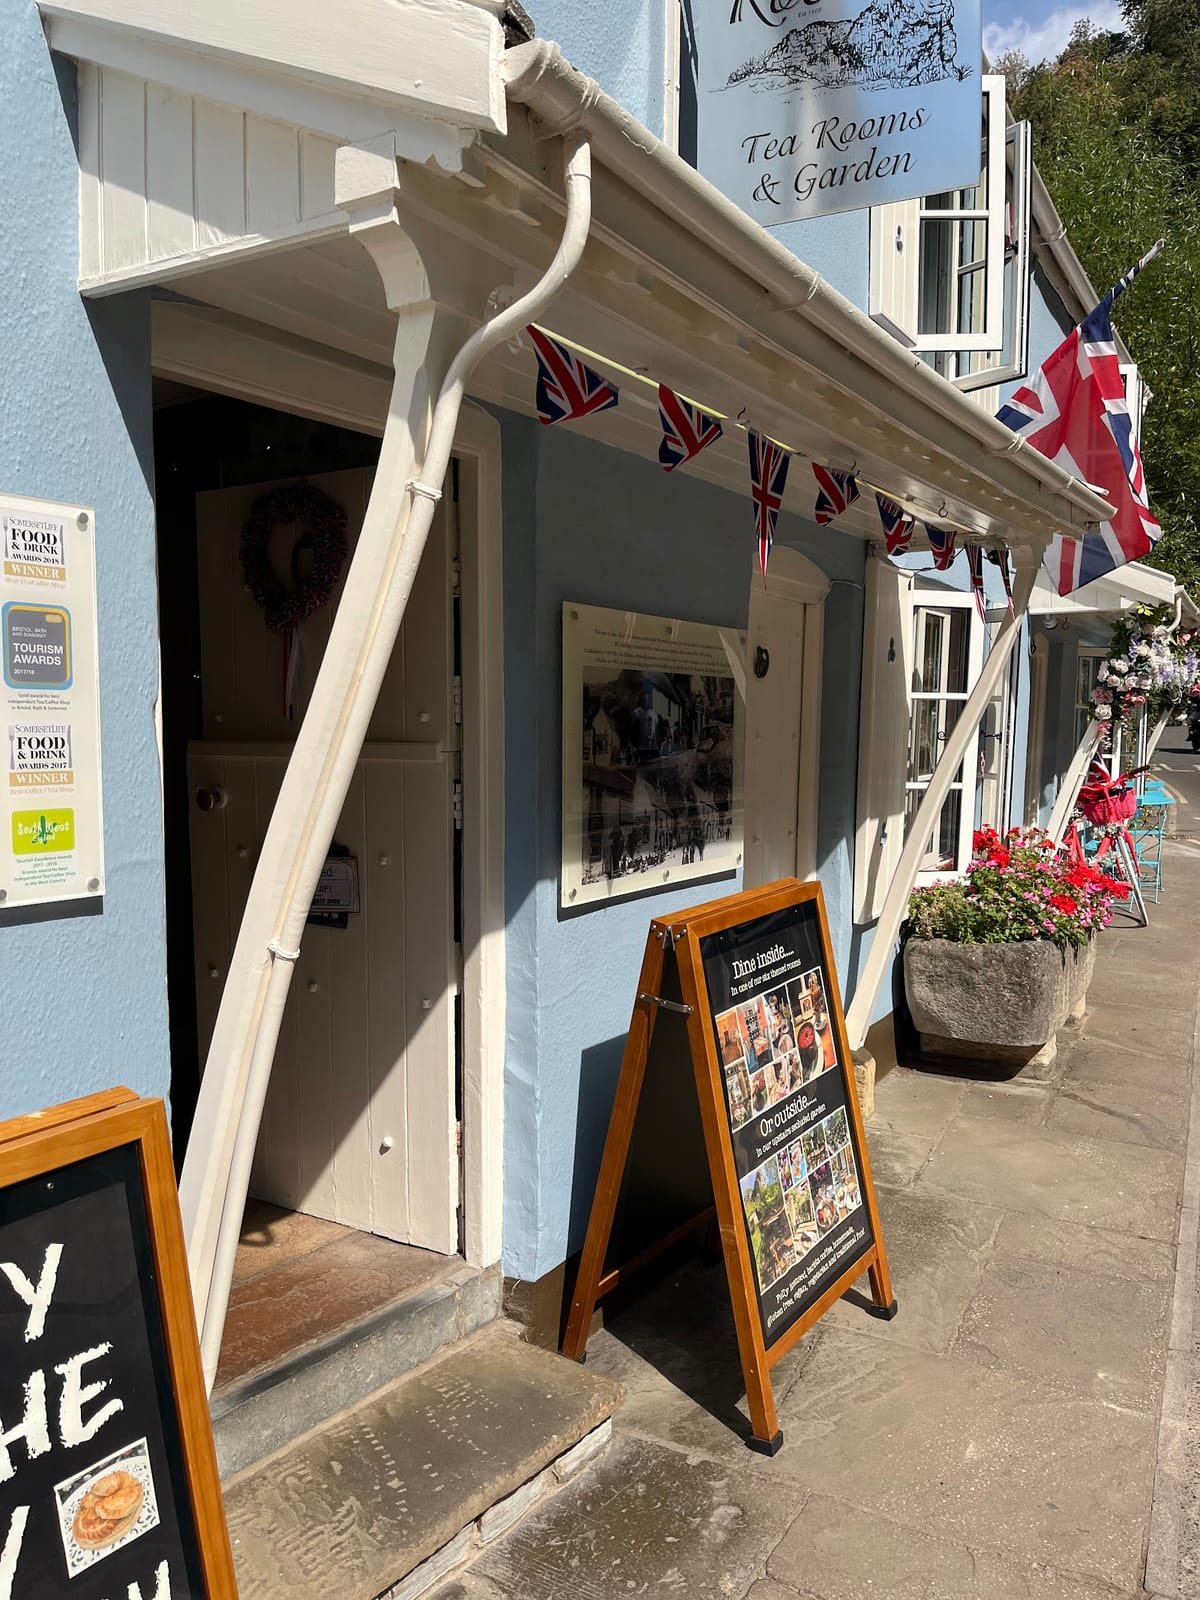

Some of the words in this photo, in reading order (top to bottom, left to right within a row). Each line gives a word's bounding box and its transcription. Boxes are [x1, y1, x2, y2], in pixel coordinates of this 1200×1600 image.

[742, 132, 800, 164] Tea
[812, 108, 930, 152] Rooms
[752, 174, 781, 205] &
[794, 148, 917, 201] Garden
[12, 528, 58, 546] FOOD
[12, 542, 20, 550] &
[24, 543, 58, 555] DRINK
[12, 554, 42, 562] AWARDS
[12, 564, 59, 578] WINNER
[13, 643, 63, 655] TOURISM
[14, 654, 61, 666] AWARDS
[17, 737, 65, 750] FOOD
[18, 751, 26, 759] &
[31, 750, 66, 760] DRINK
[16, 773, 68, 784] WINNER
[17, 822, 42, 835] South
[46, 821, 70, 832] West
[732, 957, 756, 980] Dine
[730, 986, 738, 996] In
[747, 978, 754, 990] of
[754, 976, 762, 987] our
[762, 972, 770, 983] six
[770, 963, 787, 980] themed
[786, 959, 801, 973] rooms
[760, 1118, 773, 1136] Or
[762, 1141, 772, 1153] our
[791, 1114, 810, 1133] secluded
[810, 1102, 826, 1120] garden
[808, 1263, 829, 1287] vegetarian
[828, 1255, 837, 1267] and
[836, 1235, 856, 1259] traditional
[855, 1227, 865, 1241] food
[0, 1244, 64, 1342] Y
